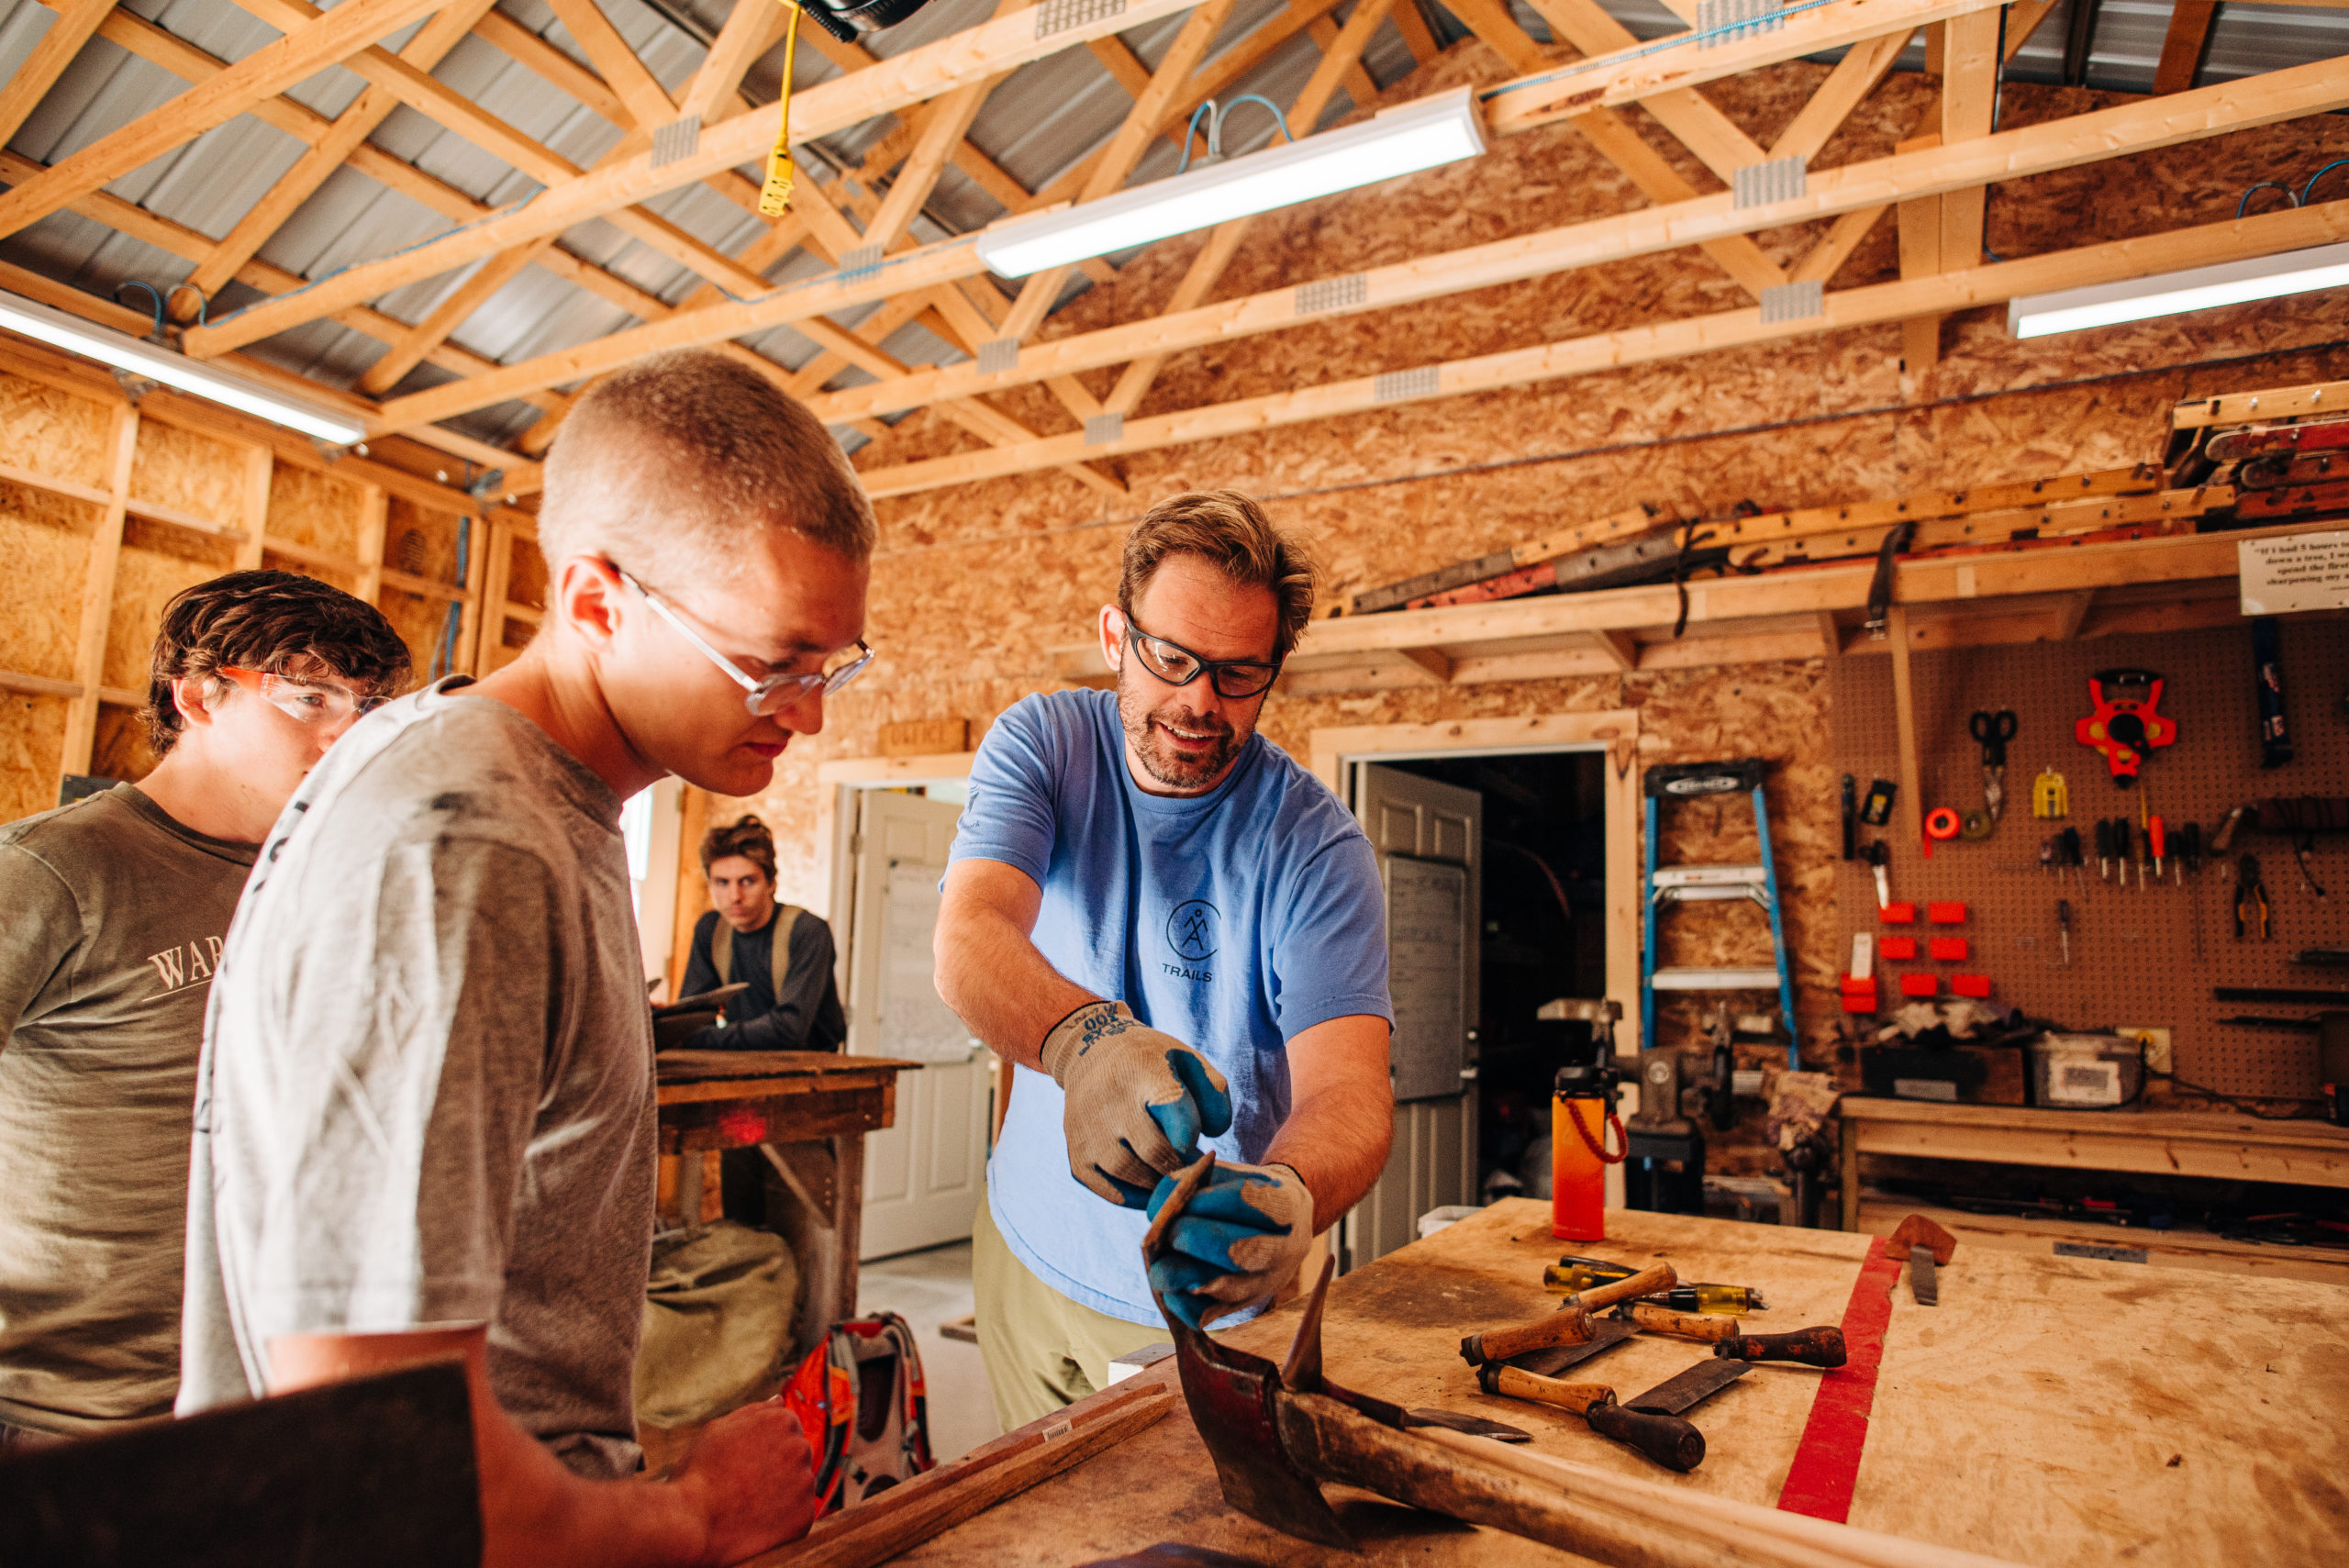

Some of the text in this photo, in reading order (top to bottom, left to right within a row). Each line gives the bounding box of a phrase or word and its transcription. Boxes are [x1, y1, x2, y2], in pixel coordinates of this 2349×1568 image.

[2279, 545, 2297, 553] had
[2277, 565, 2306, 575] spend
[2266, 575, 2322, 584] sharpening
[1163, 963, 1213, 983] TRAILS
